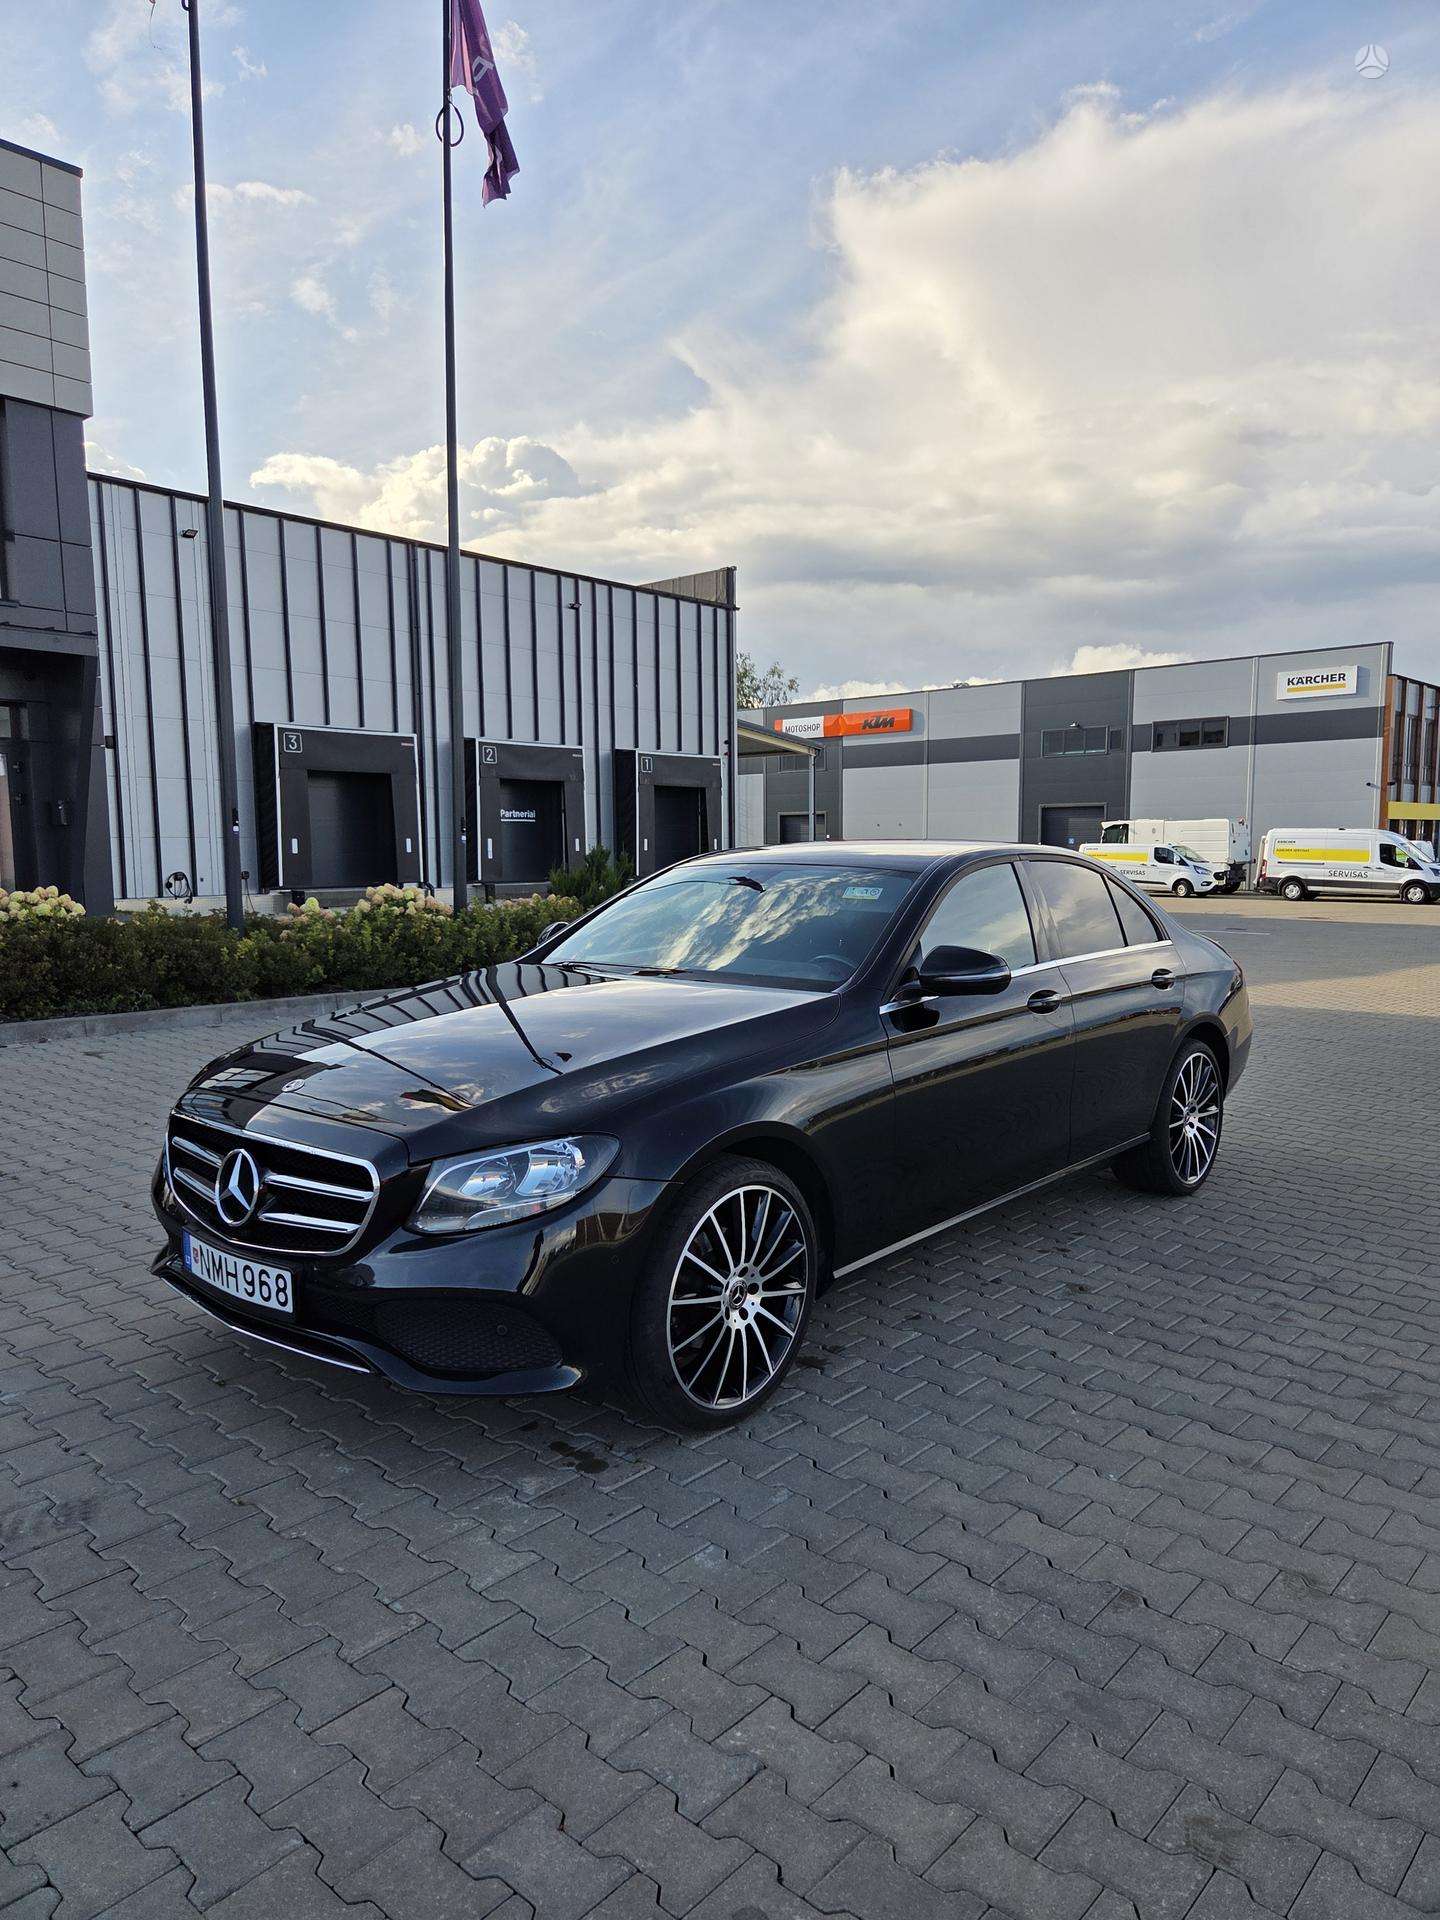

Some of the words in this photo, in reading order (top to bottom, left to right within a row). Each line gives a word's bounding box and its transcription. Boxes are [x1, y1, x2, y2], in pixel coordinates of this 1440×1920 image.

[1287, 673, 1346, 686] KÄRCHER
[785, 723, 820, 734] MOTOSHOP
[862, 717, 895, 730] KTM
[288, 735, 298, 750] 3
[486, 748, 494, 761] 2
[1328, 870, 1368, 879] SERVISAS
[200, 1245, 289, 1308] NMH968
